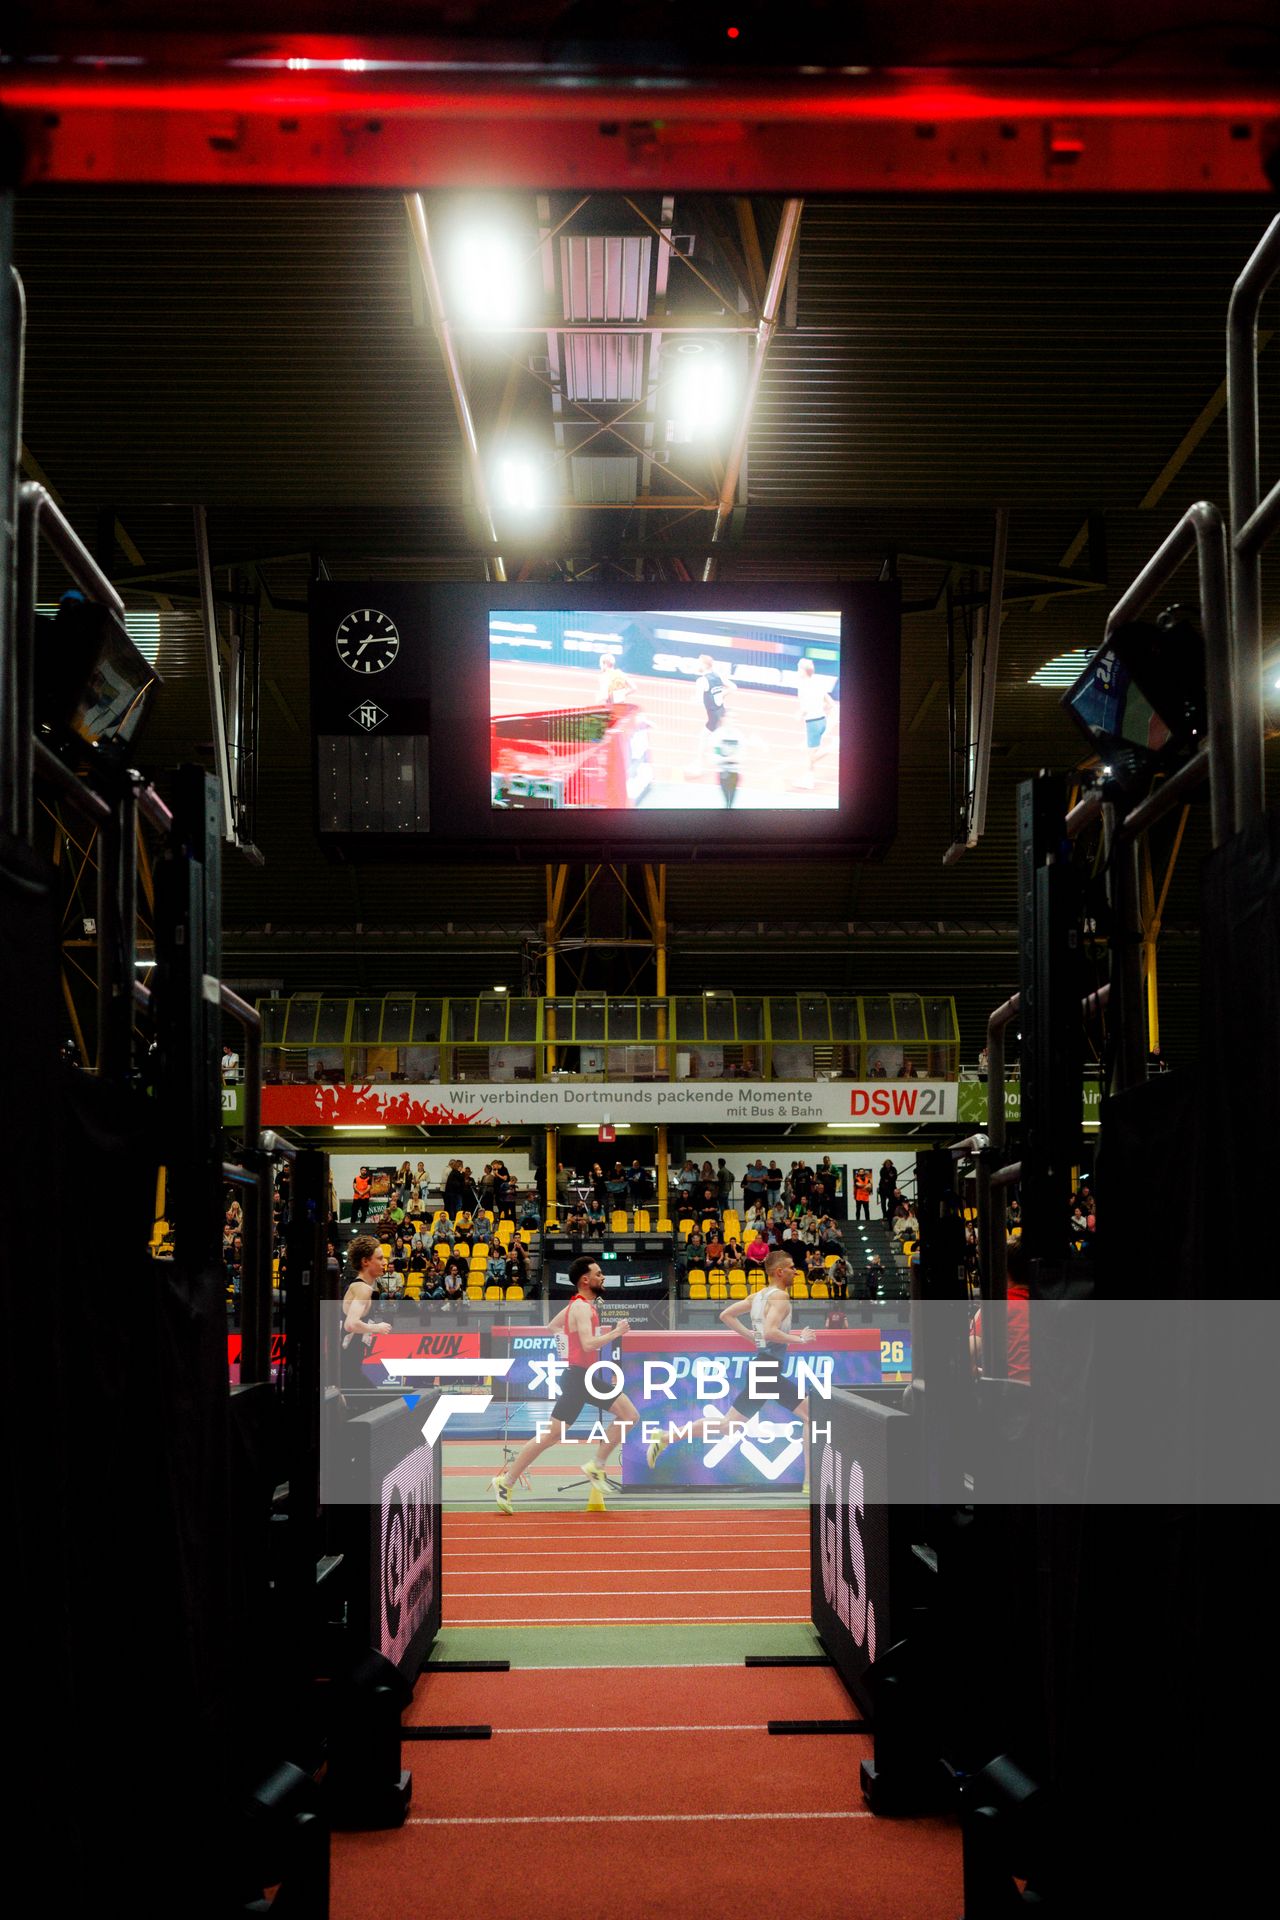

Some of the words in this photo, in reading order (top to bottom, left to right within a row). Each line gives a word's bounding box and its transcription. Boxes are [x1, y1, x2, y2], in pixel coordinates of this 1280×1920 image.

[449, 1090, 476, 1104] Wir
[480, 1090, 559, 1104] verbinden
[564, 1089, 653, 1103] Dortmunds
[657, 1089, 734, 1106] packende
[738, 1089, 813, 1102] Momente
[850, 1089, 945, 1116] DSW21
[726, 1106, 748, 1117] mit
[751, 1106, 775, 1117] Bus
[778, 1106, 787, 1117] &
[791, 1106, 823, 1117] Bahn
[602, 1127, 613, 1140] L
[416, 1335, 463, 1355] RUN
